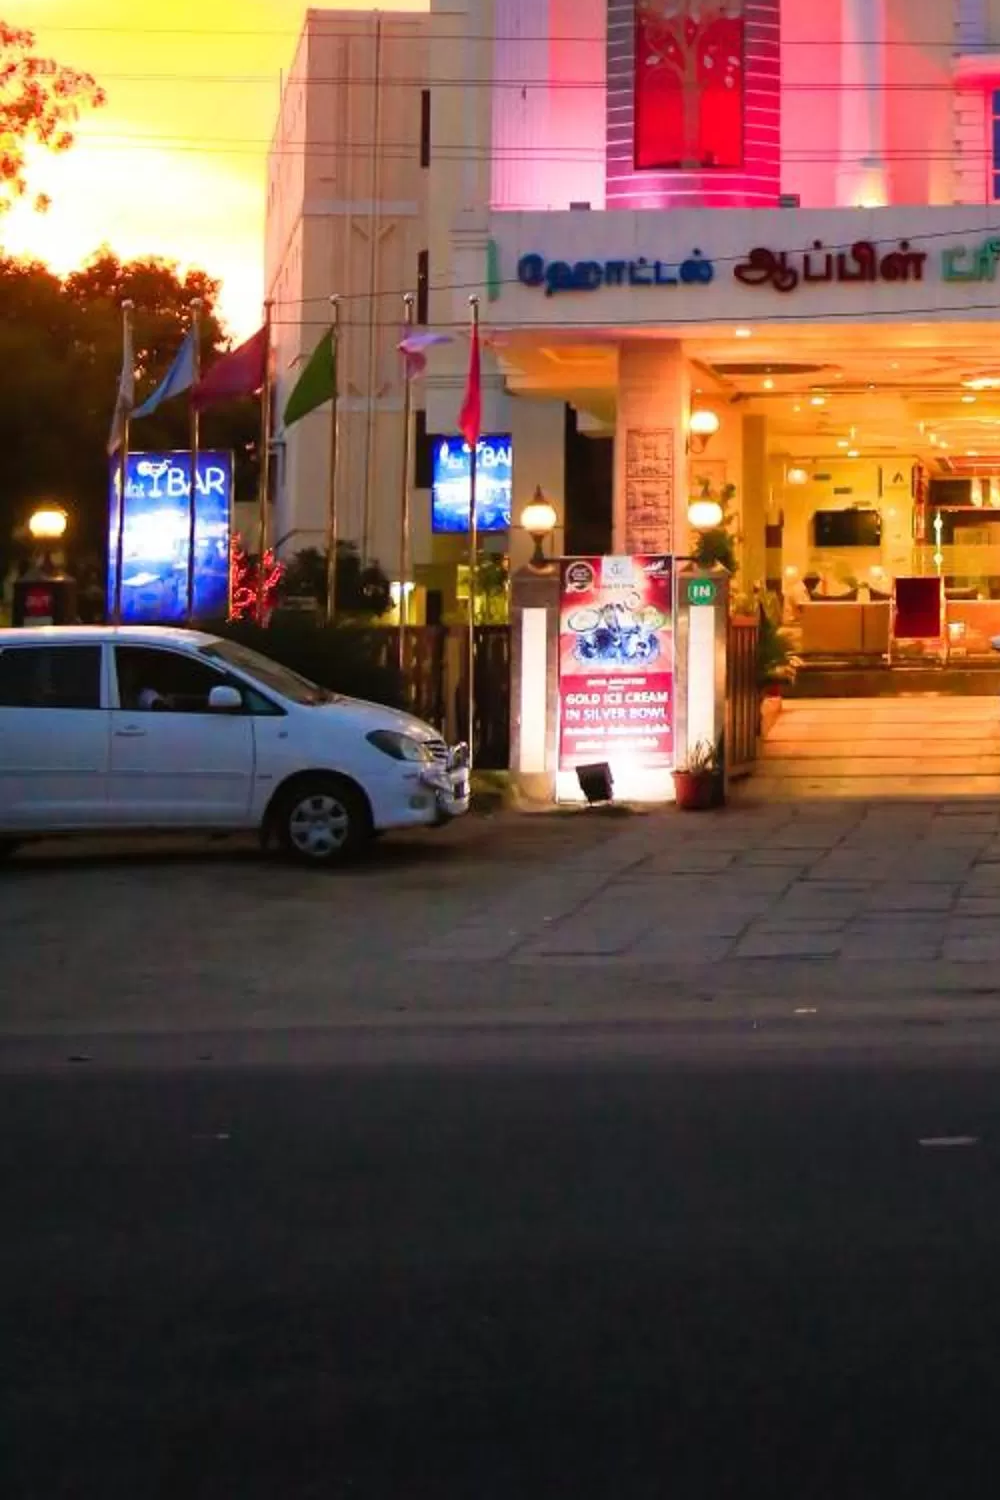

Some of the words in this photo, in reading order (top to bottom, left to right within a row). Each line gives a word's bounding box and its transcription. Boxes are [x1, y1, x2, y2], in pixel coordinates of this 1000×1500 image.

[482, 446, 512, 468] BA
[166, 466, 225, 496] BAR
[693, 584, 711, 597] IN
[565, 693, 600, 705] GOLD
[603, 692, 623, 705] ICE
[625, 691, 669, 703] CREAM
[565, 709, 580, 721] IN
[583, 708, 626, 721] SILVER
[629, 707, 667, 719] BOWL
